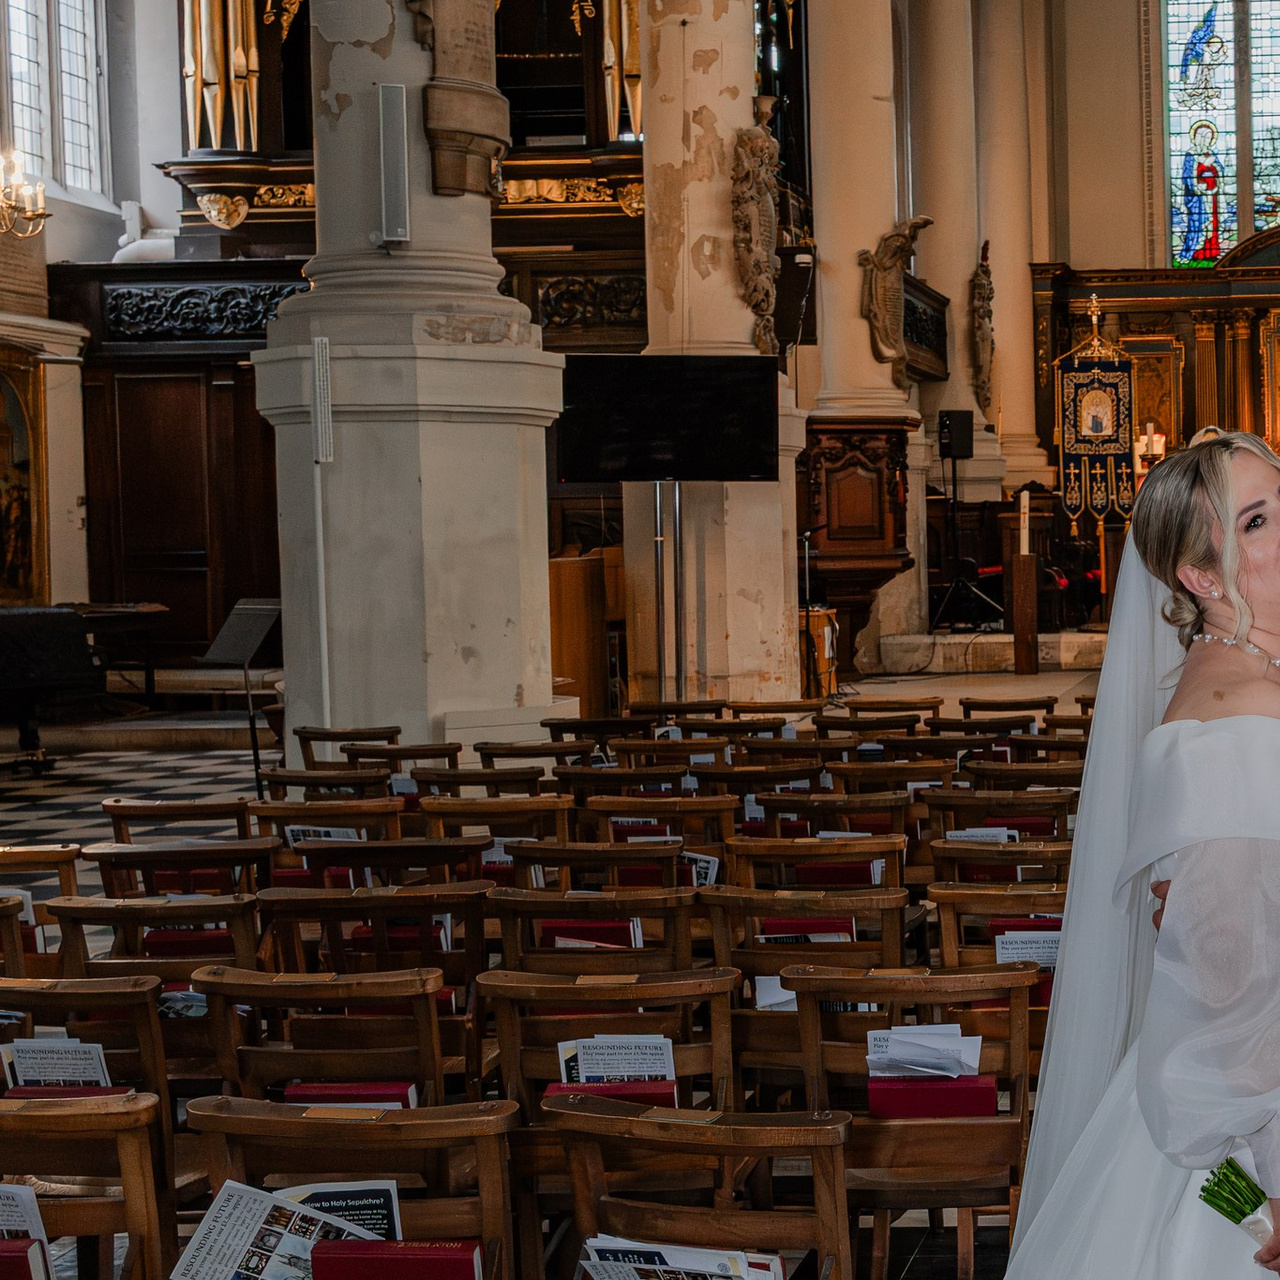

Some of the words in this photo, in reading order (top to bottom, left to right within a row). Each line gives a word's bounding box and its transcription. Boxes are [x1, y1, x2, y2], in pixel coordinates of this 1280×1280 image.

[347, 1197, 384, 1208] Sepulchre?
[180, 1223, 217, 1278] RESOUNDING
[213, 1191, 236, 1225] FUTURE
[189, 1268, 203, 1280] Play
[206, 1241, 216, 1257] part
